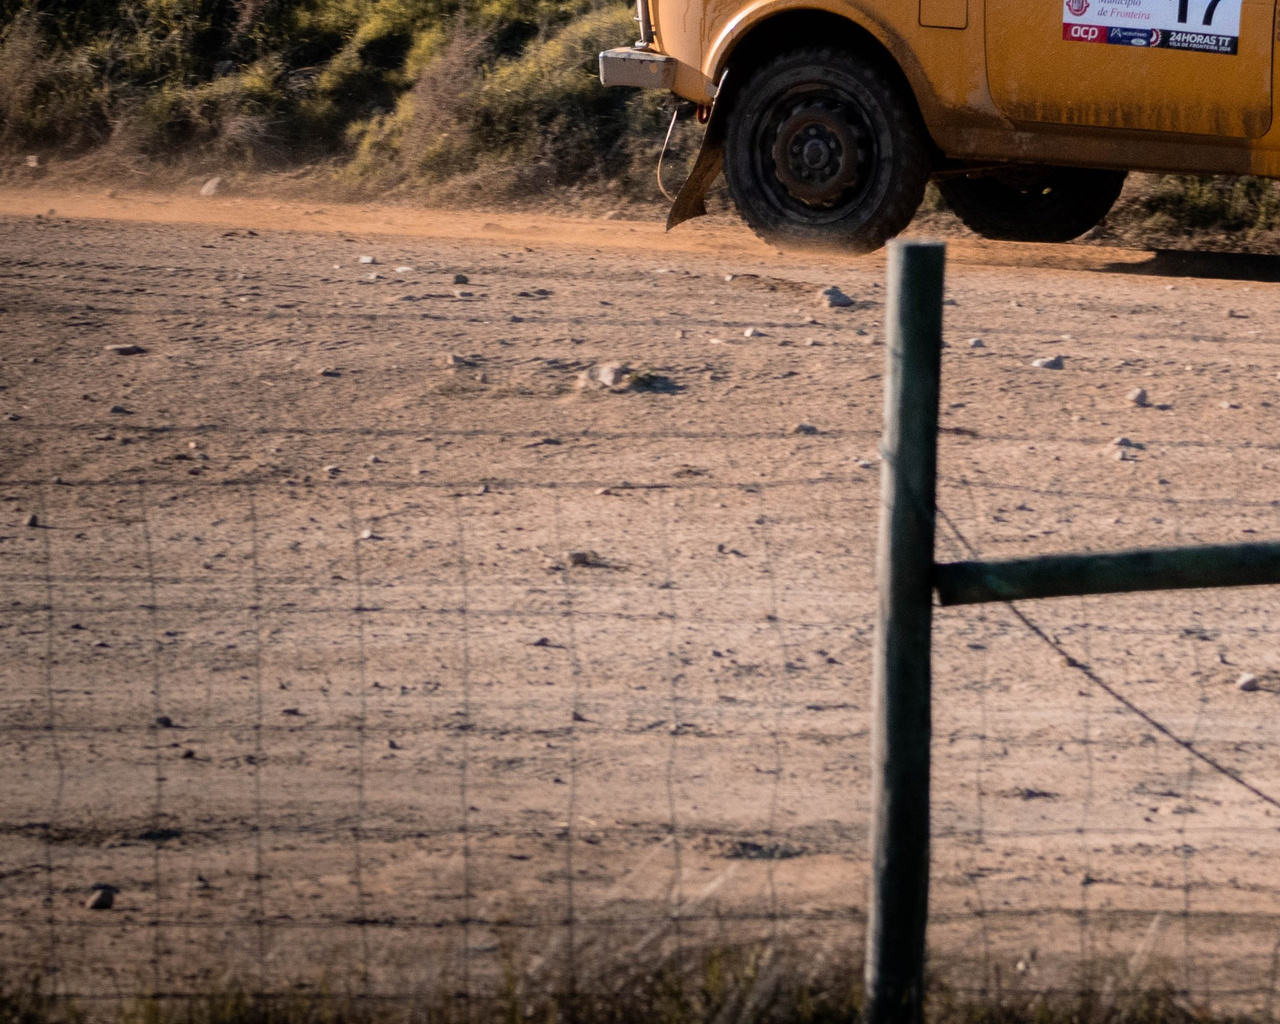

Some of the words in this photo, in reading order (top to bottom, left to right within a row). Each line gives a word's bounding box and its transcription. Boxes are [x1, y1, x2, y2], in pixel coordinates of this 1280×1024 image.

[1097, 7, 1108, 17] de
[1110, 8, 1151, 20] Fronteira
[1071, 26, 1098, 40] acp
[1169, 32, 1217, 45] 24HORAS
[1218, 37, 1231, 46] TT
